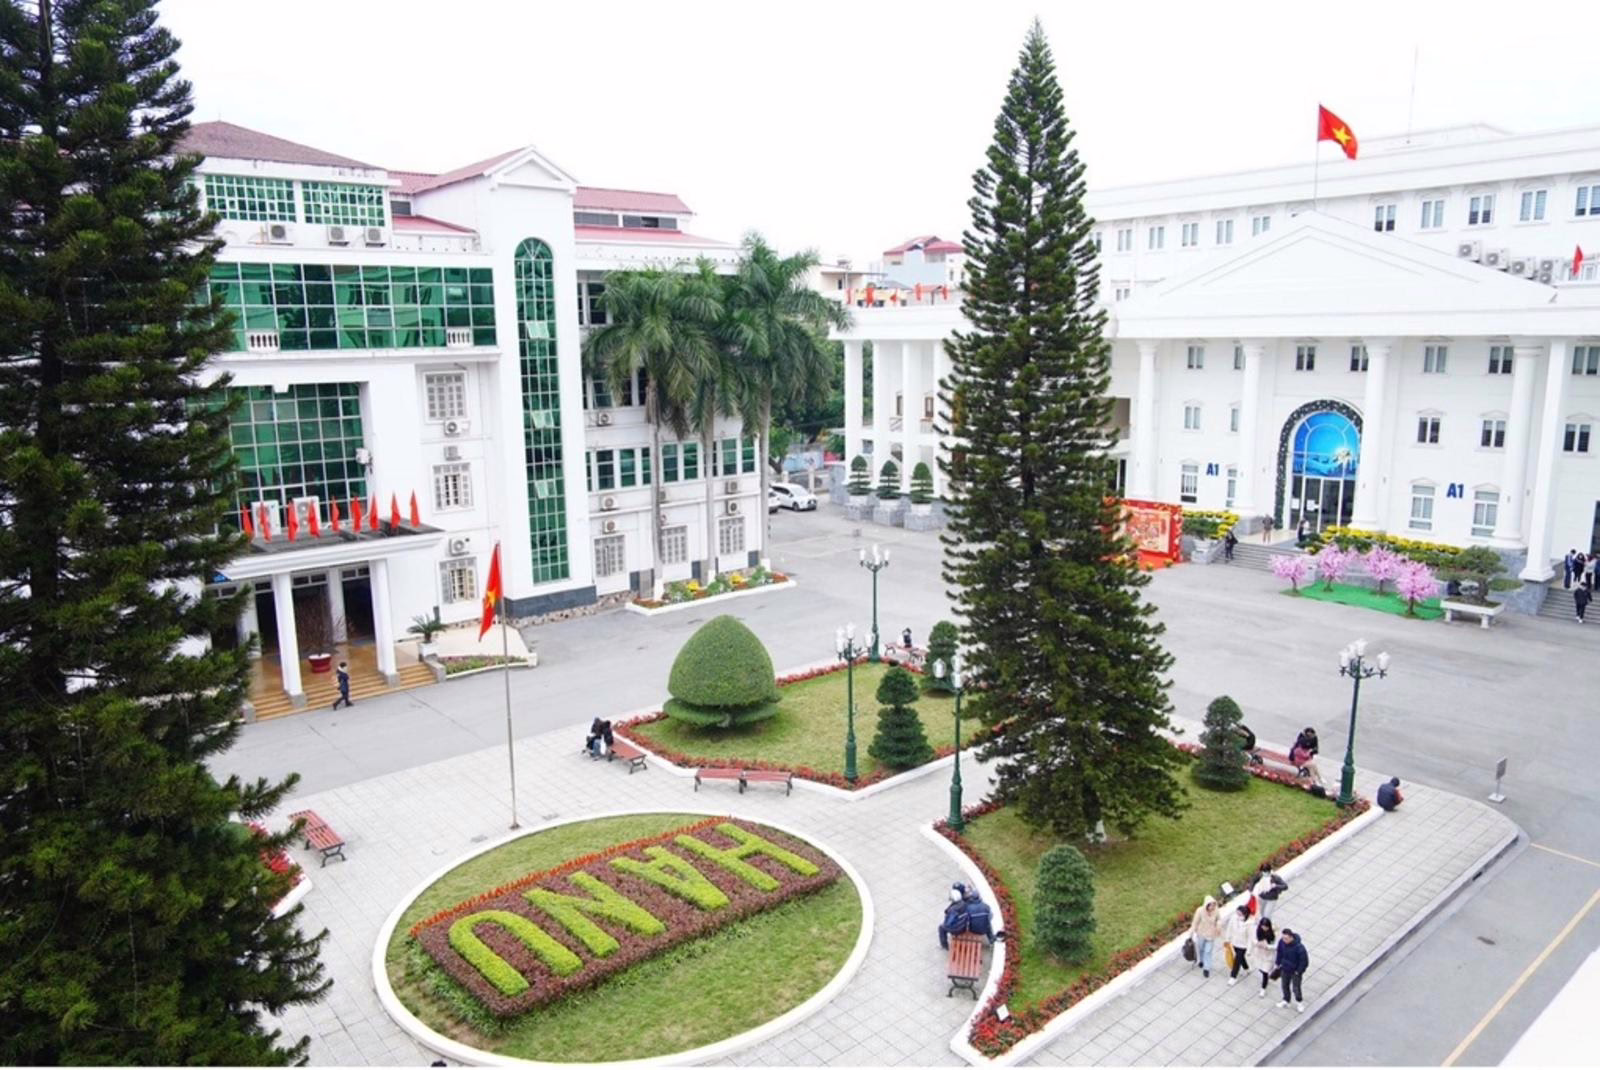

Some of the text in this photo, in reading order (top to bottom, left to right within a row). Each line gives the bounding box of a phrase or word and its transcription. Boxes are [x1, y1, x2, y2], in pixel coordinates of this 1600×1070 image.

[1206, 462, 1219, 476] A1
[1446, 482, 1464, 498] A1
[448, 821, 821, 996] HANU
